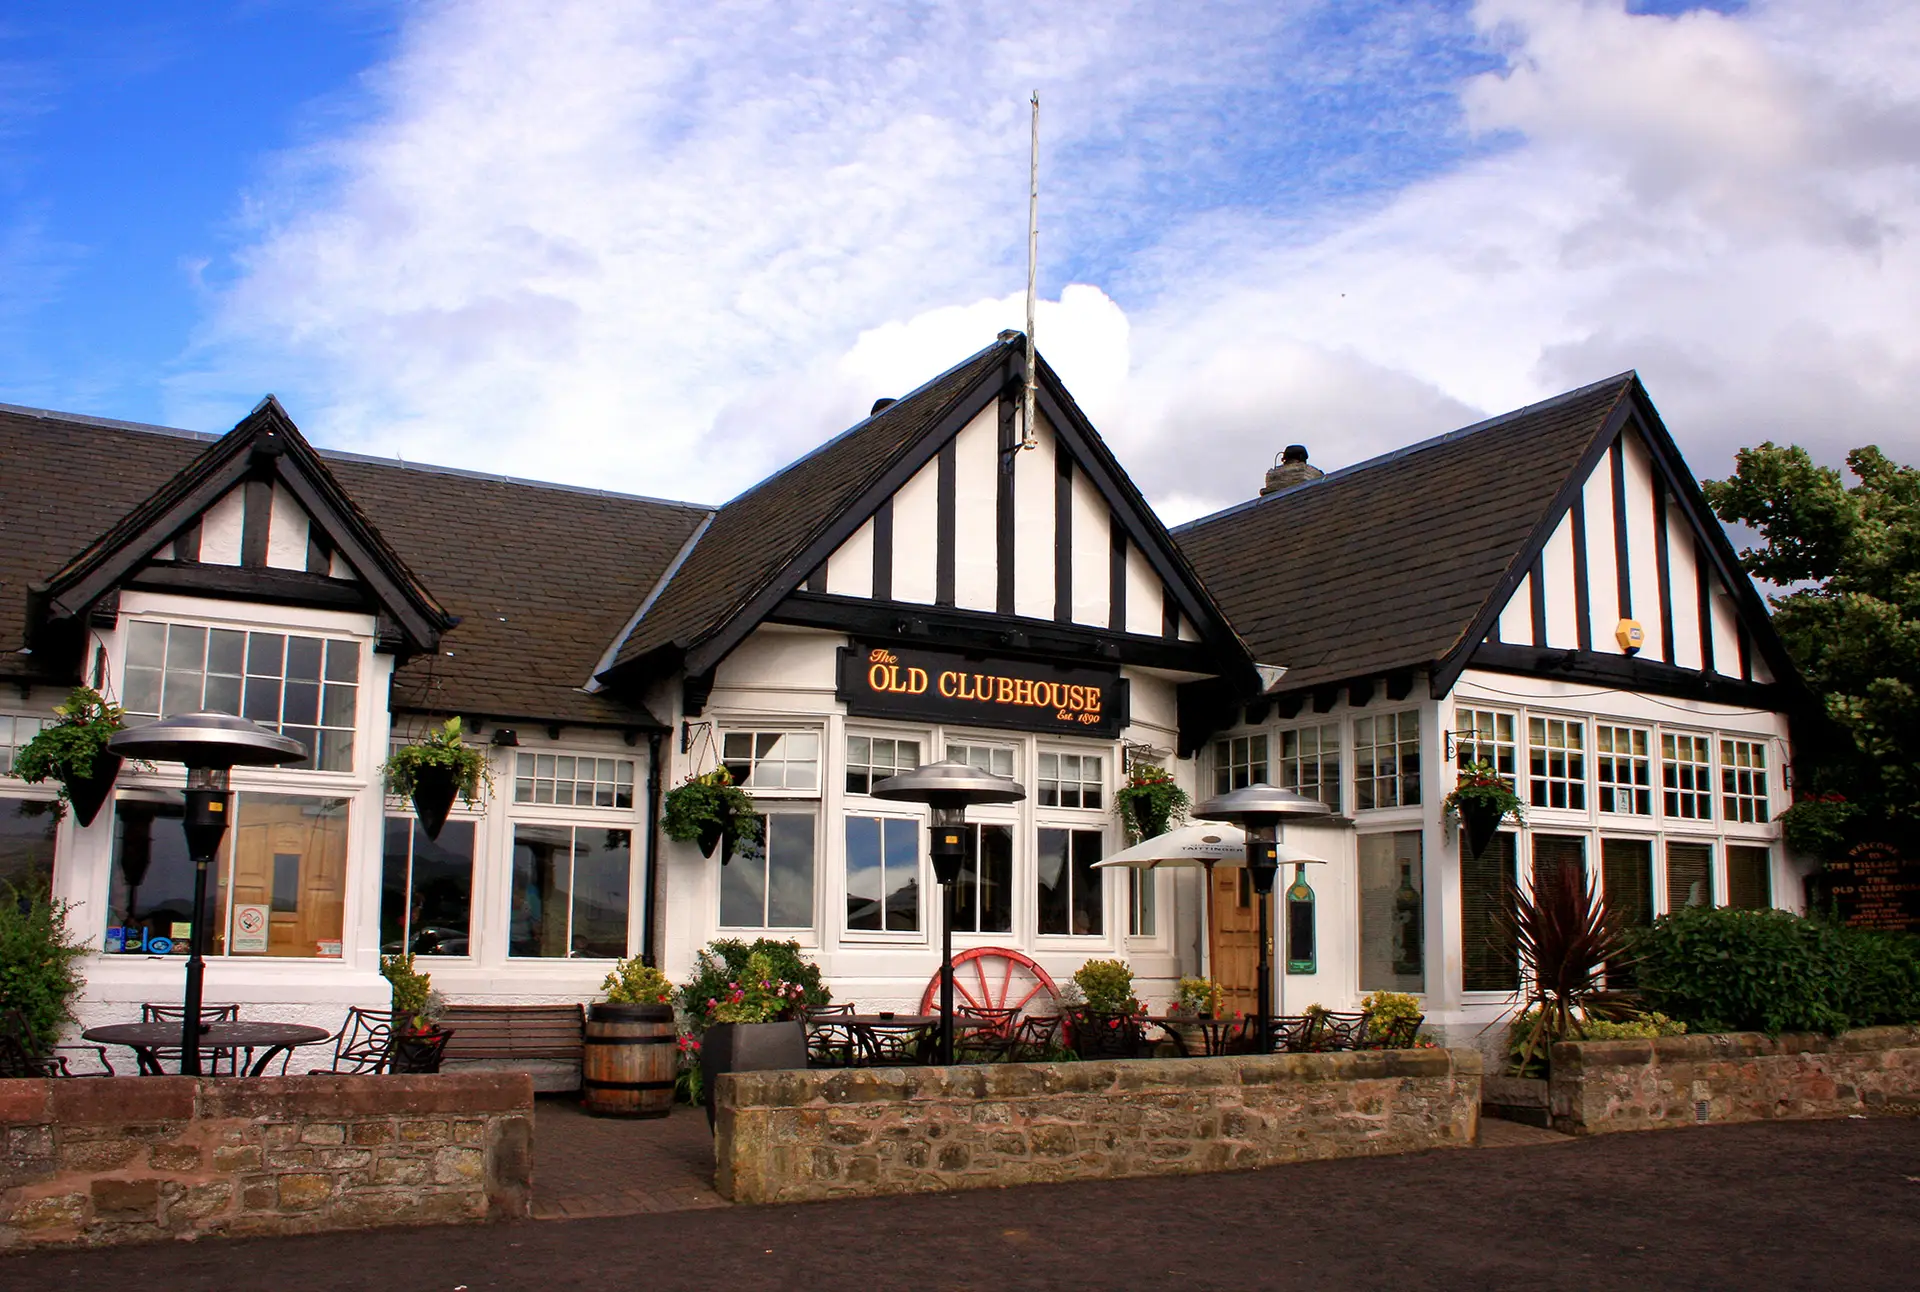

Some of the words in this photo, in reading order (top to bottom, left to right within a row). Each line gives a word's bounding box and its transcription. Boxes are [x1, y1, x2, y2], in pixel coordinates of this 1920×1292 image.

[869, 648, 898, 664] The
[868, 663, 928, 694] OLD
[938, 670, 1101, 713] CLUBHOUSE
[1056, 709, 1074, 721] Est.
[1077, 712, 1101, 725] 1890
[1848, 841, 1900, 857] WELCOME
[1832, 885, 1855, 895] OLD
